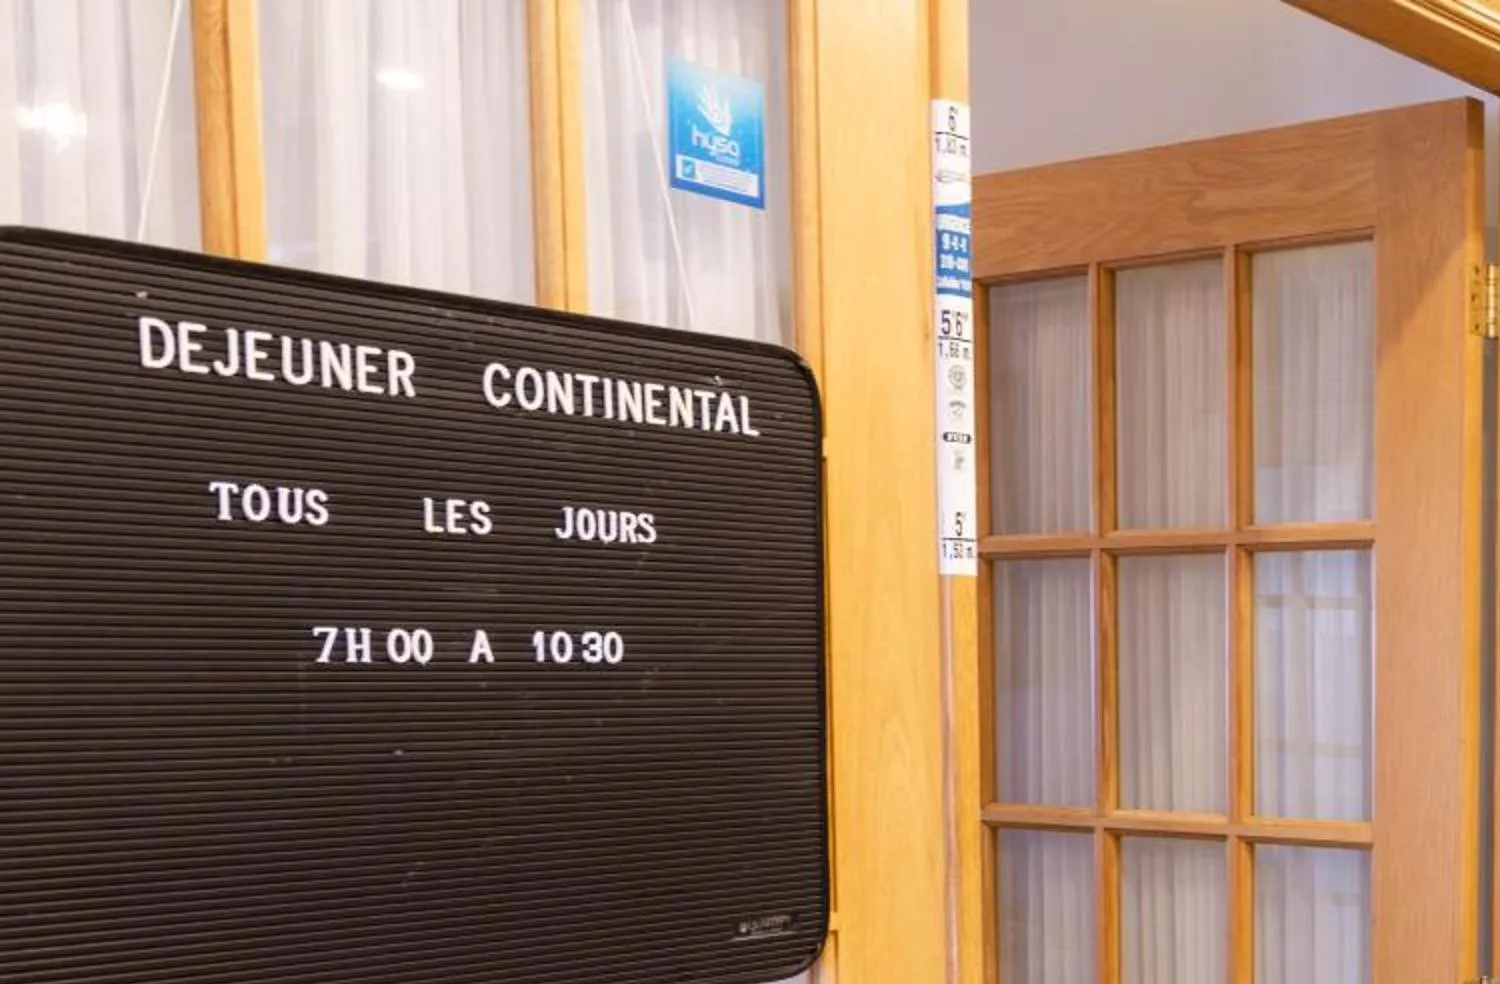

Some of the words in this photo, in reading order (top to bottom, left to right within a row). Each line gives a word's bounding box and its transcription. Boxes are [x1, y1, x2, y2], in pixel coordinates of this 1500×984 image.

[138, 316, 416, 398] DEJEUNER
[482, 362, 761, 437] CONTINENTAL
[208, 480, 330, 526] TOUS
[423, 497, 493, 535] LES
[554, 506, 657, 544] JOURS
[468, 629, 495, 664] A
